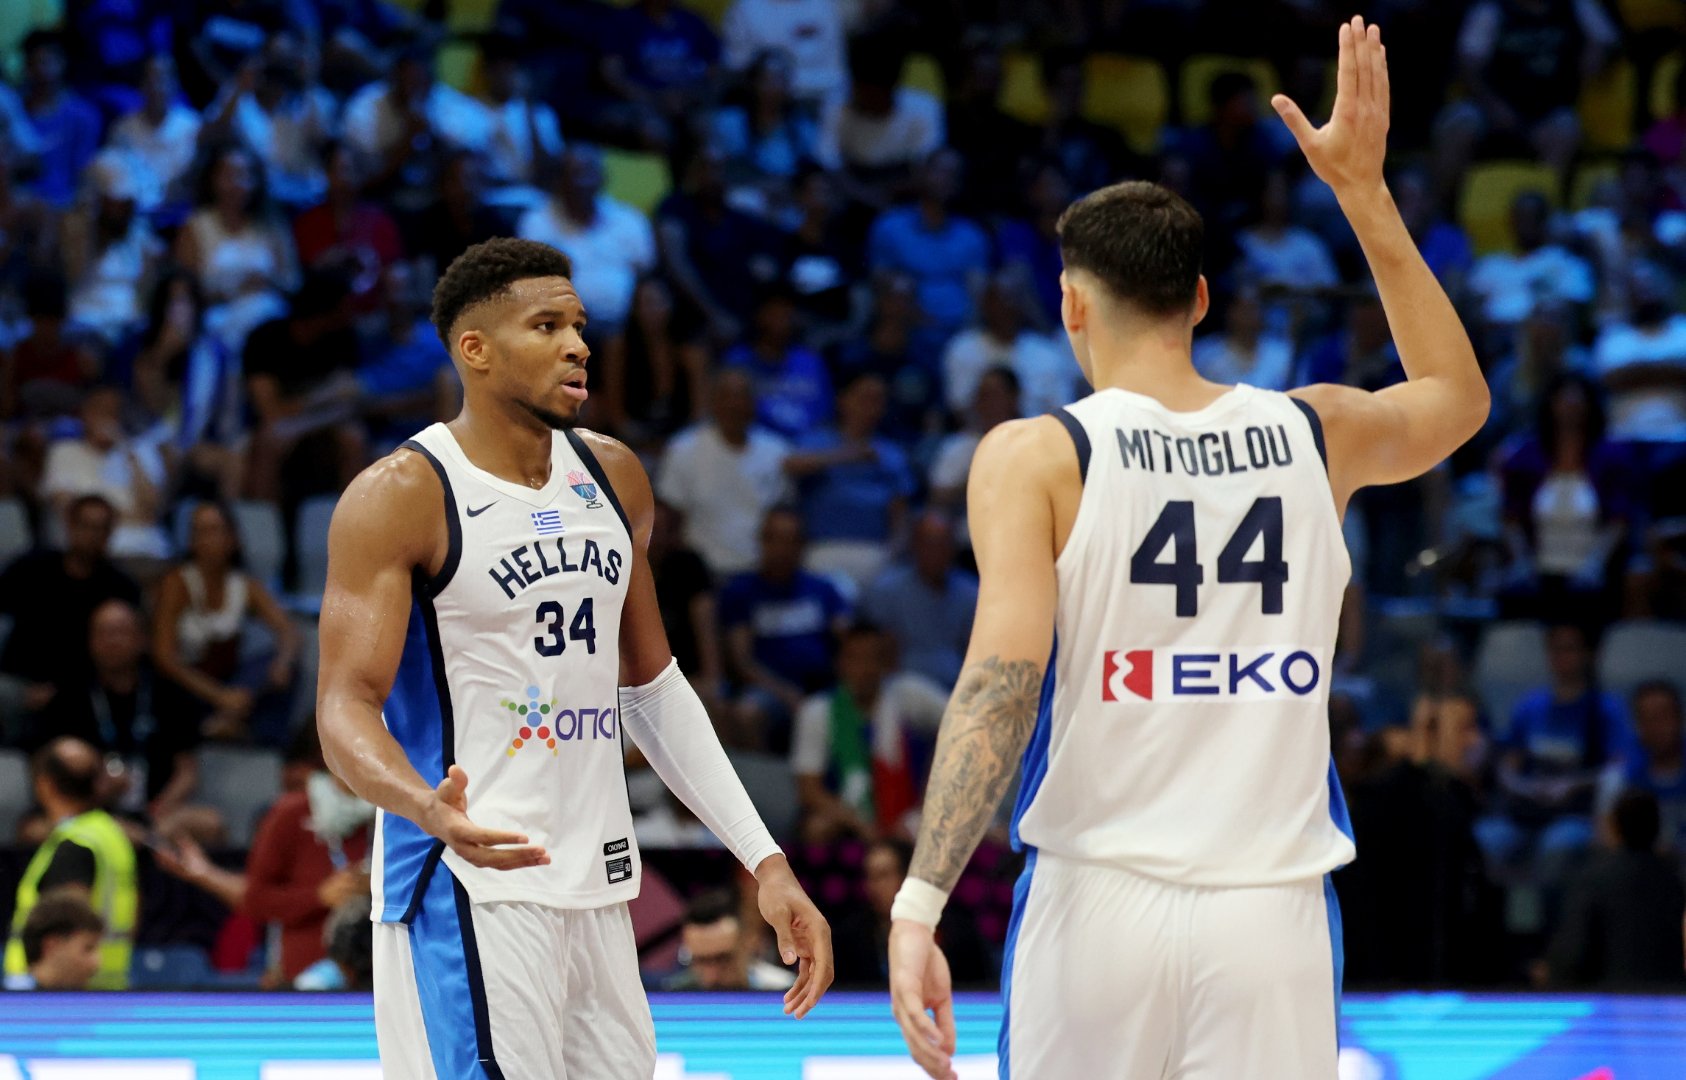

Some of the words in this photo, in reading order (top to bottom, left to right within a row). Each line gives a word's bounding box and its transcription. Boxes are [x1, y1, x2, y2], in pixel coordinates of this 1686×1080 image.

[1115, 424, 1293, 477] MITOGLOU
[488, 537, 622, 600] HELLAS
[1129, 496, 1289, 618] 44
[534, 597, 596, 657] 34
[1172, 650, 1320, 696] EKO
